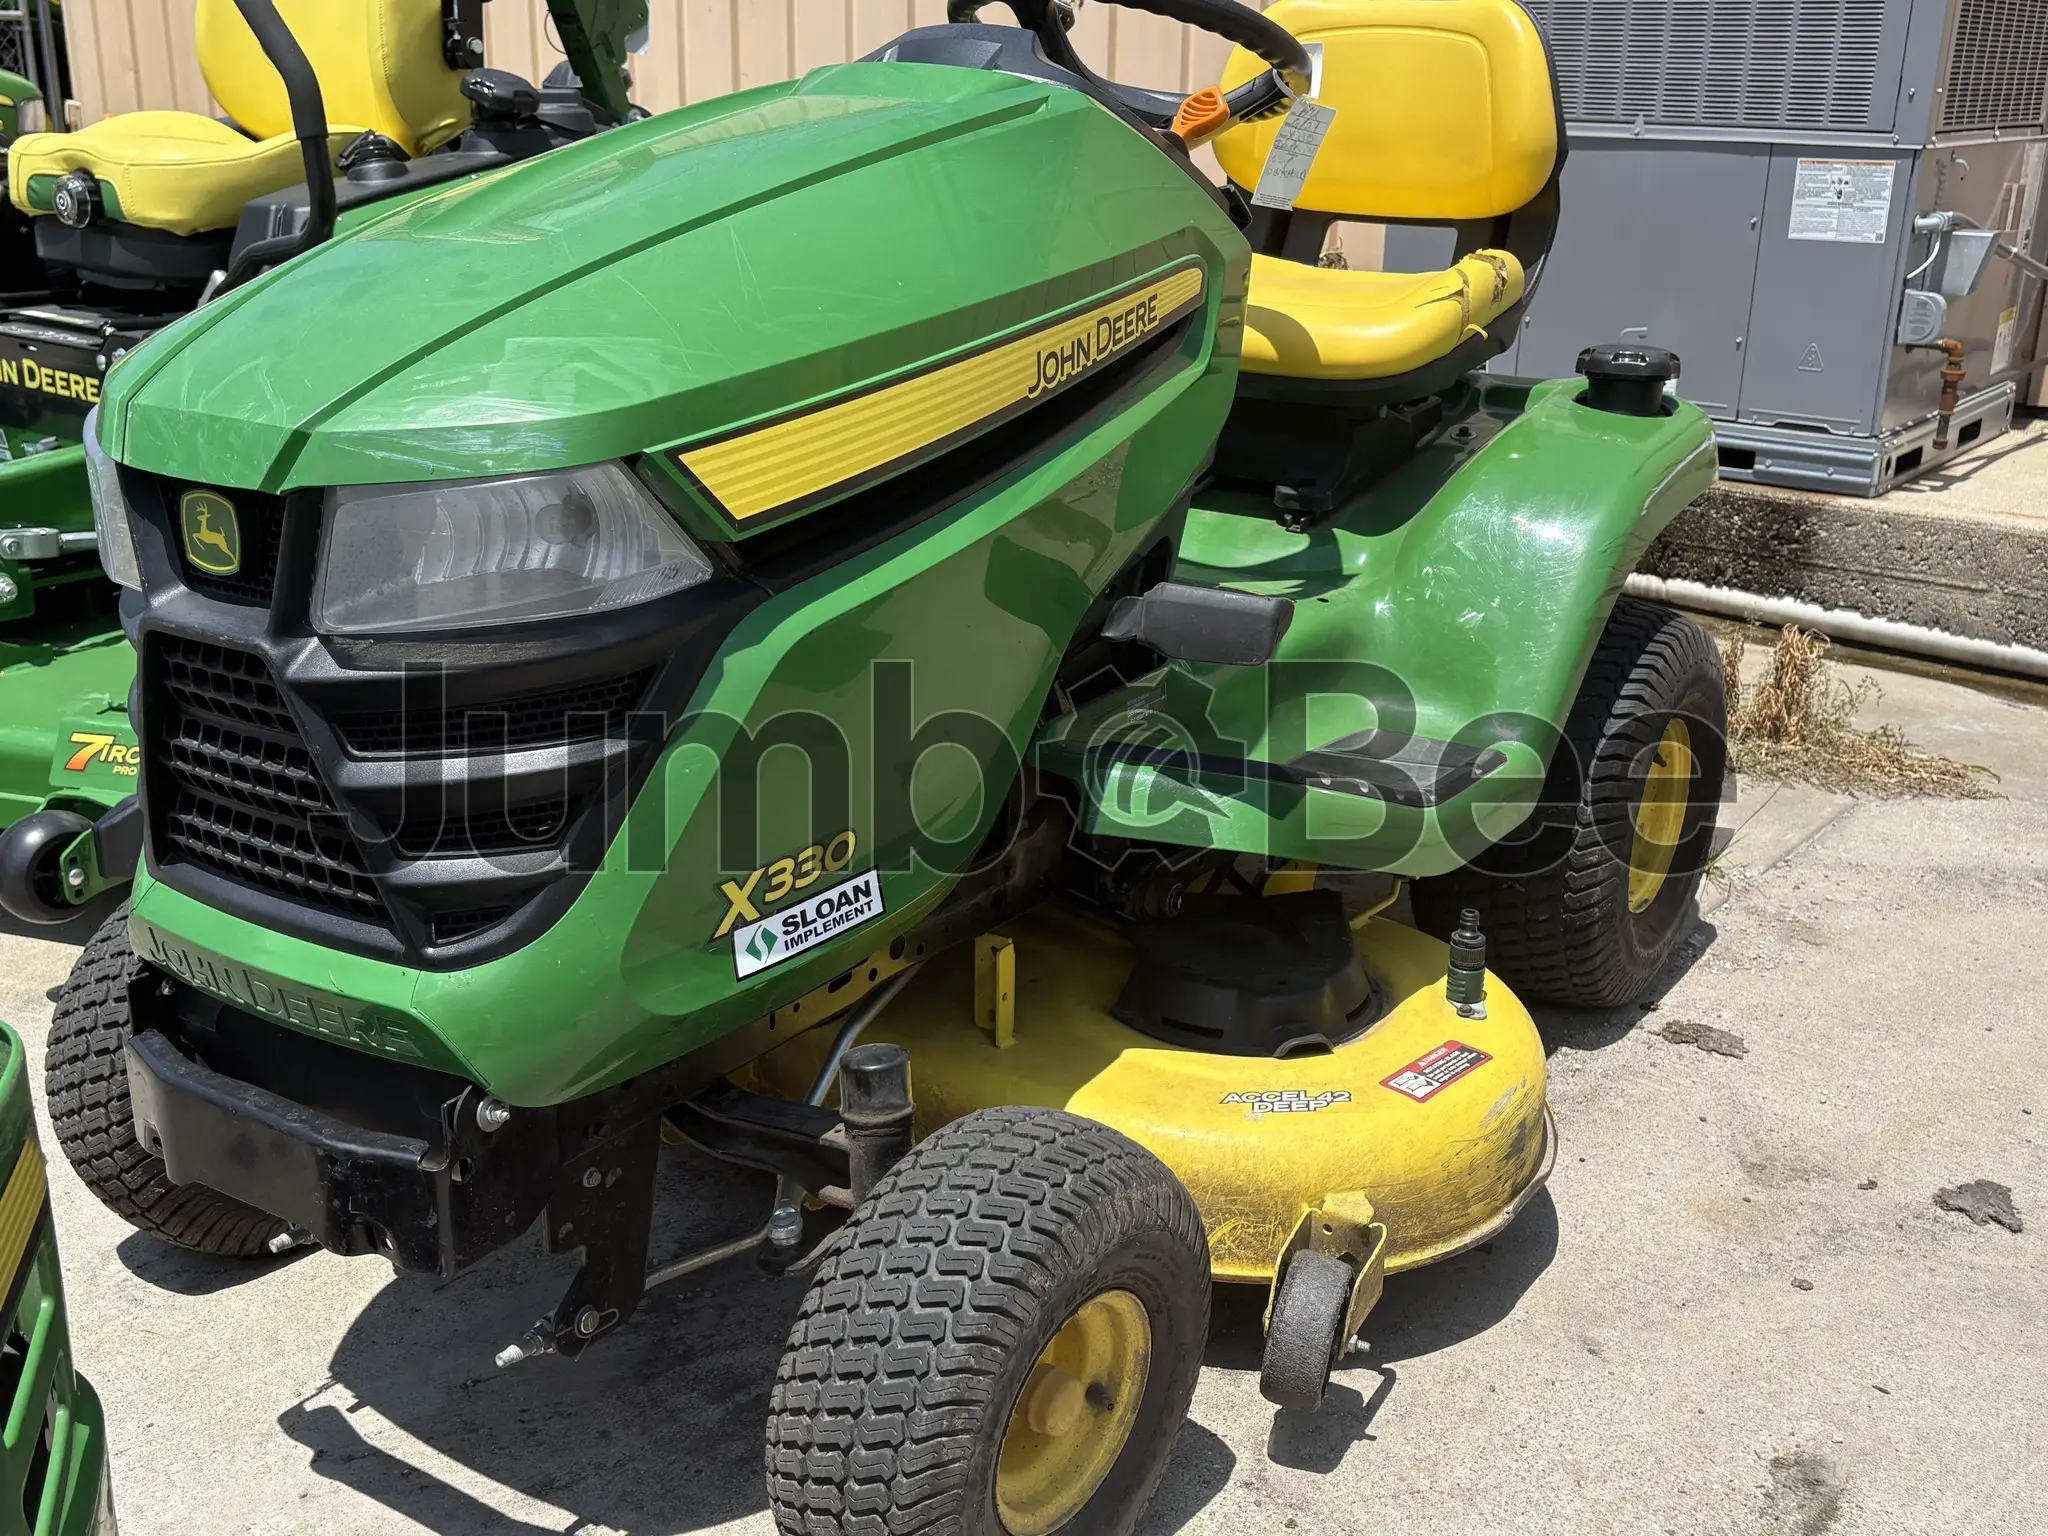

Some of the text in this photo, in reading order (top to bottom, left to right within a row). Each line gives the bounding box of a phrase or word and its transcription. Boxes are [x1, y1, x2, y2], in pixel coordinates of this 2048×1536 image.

[1027, 293, 1159, 399] JOHN DEERE
[22, 358, 100, 403] DEERE
[112, 765, 138, 776] PRO
[708, 828, 857, 944] X330
[782, 880, 872, 937] SLOAN
[784, 899, 874, 951] IMPLEMENT
[149, 927, 424, 1057] JOHN DEERE
[1252, 1100, 1330, 1113] DEEP
